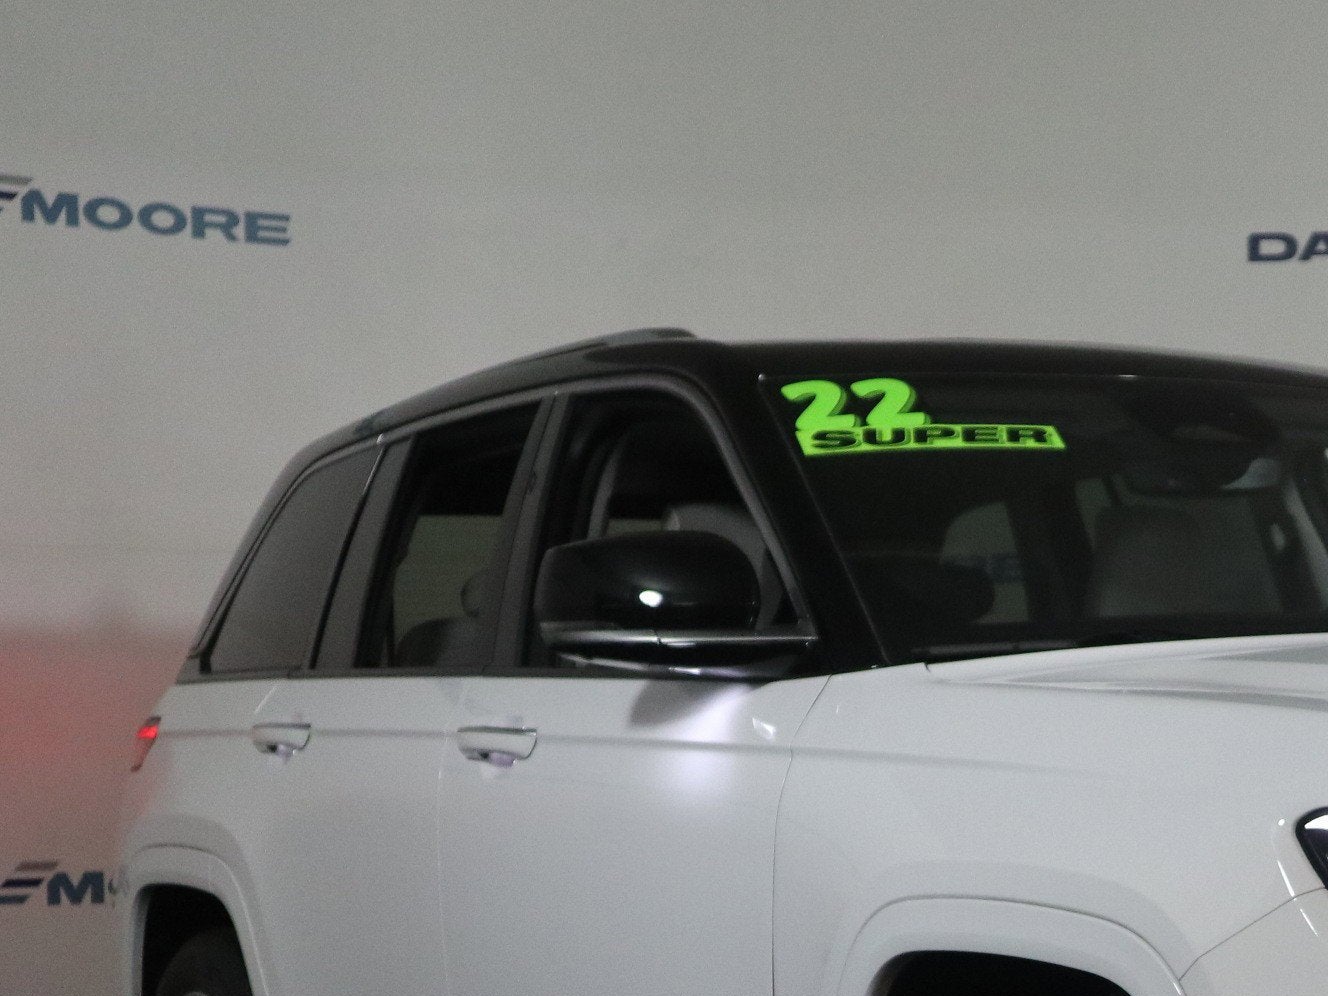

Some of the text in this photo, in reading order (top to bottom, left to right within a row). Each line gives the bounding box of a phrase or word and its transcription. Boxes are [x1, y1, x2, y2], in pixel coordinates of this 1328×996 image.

[20, 188, 291, 246] MOORE
[780, 377, 931, 430] 22
[811, 426, 1052, 449] SUPER
